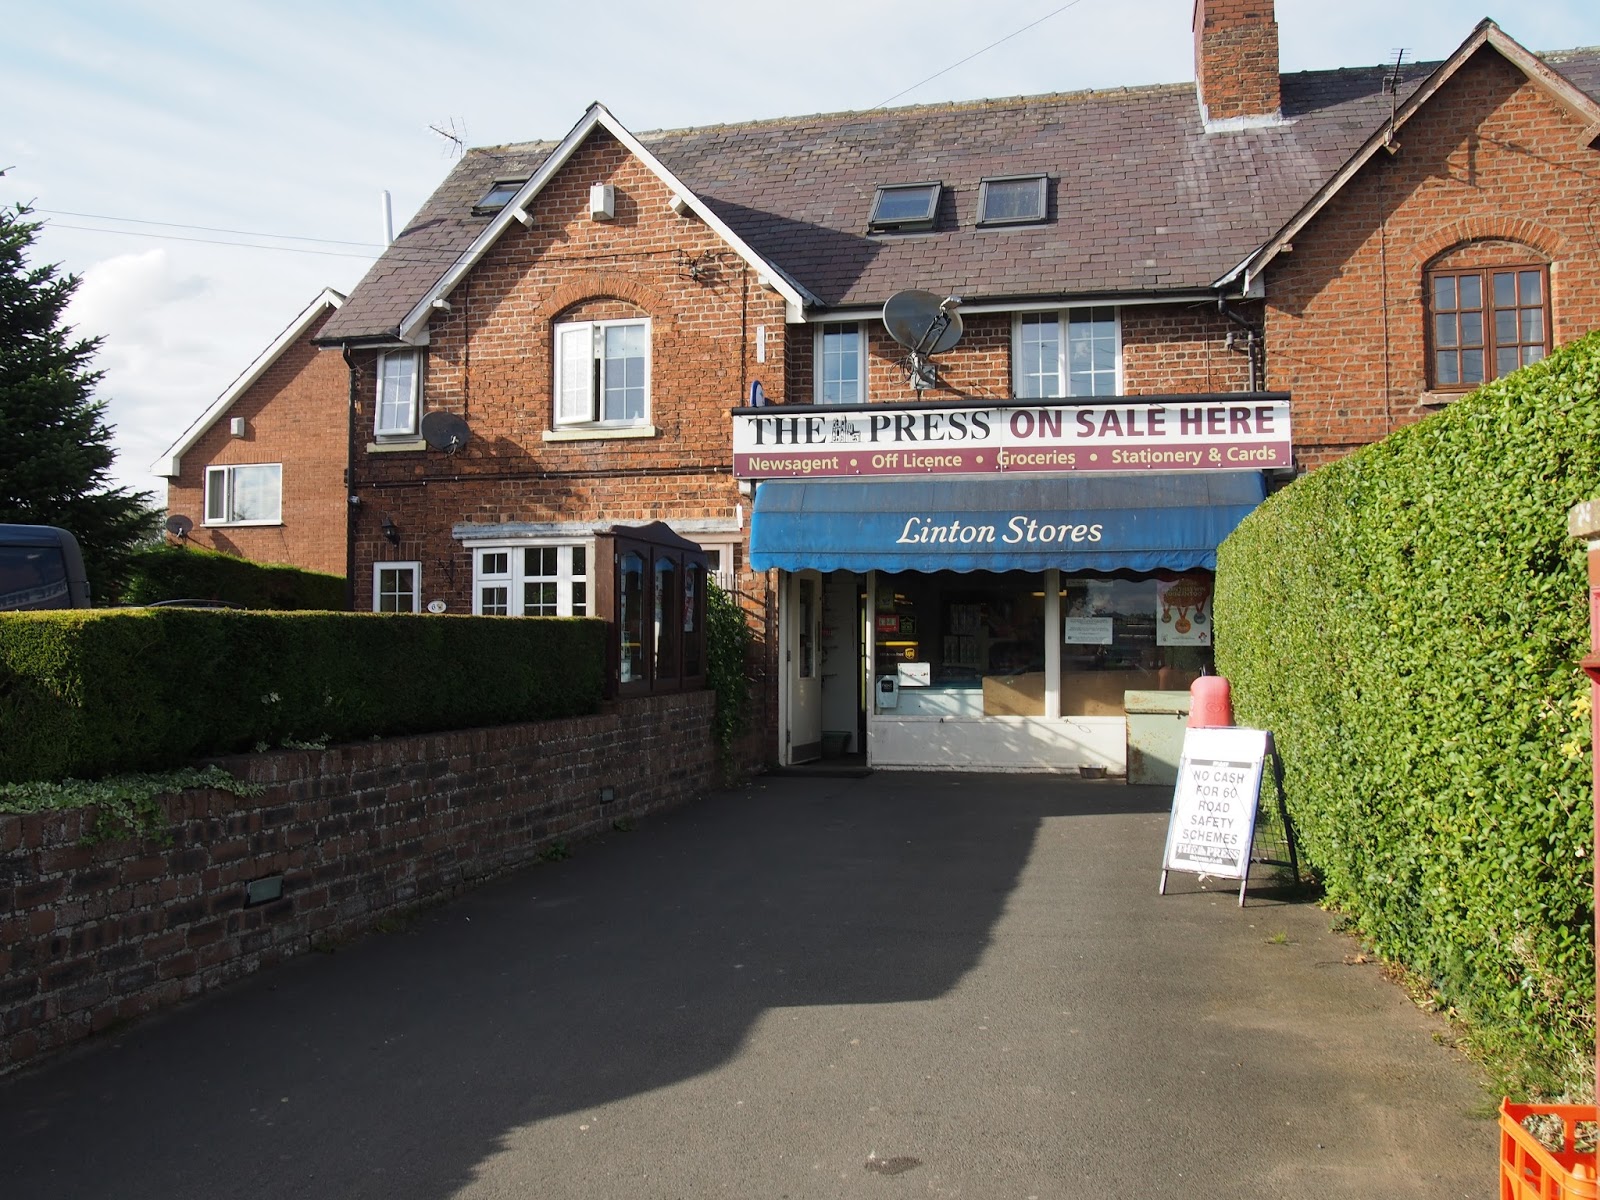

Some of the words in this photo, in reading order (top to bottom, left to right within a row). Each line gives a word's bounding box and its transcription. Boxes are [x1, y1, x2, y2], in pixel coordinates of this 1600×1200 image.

[748, 417, 827, 445] THE
[868, 410, 991, 443] PRESS
[1009, 409, 1062, 439] ON
[1076, 408, 1167, 438] SALE
[1180, 405, 1275, 436] HERE
[748, 456, 839, 474] Newsagent
[871, 454, 898, 470] Off
[903, 453, 962, 469] Licence
[997, 451, 1076, 466] Groceries
[1111, 448, 1203, 467] Stationery
[1208, 448, 1222, 463] &
[1226, 446, 1277, 463] Cards
[896, 516, 996, 544] Linton
[1001, 515, 1103, 543] Stores
[1194, 771, 1209, 781] NO
[1214, 771, 1245, 784] CASH
[1196, 785, 1219, 797] FOR
[1224, 788, 1238, 799] 60
[1198, 801, 1230, 814] ROAD
[1190, 815, 1234, 829] SAFETY
[1182, 829, 1238, 845] SCHEMES
[1206, 847, 1240, 859] PRESS
